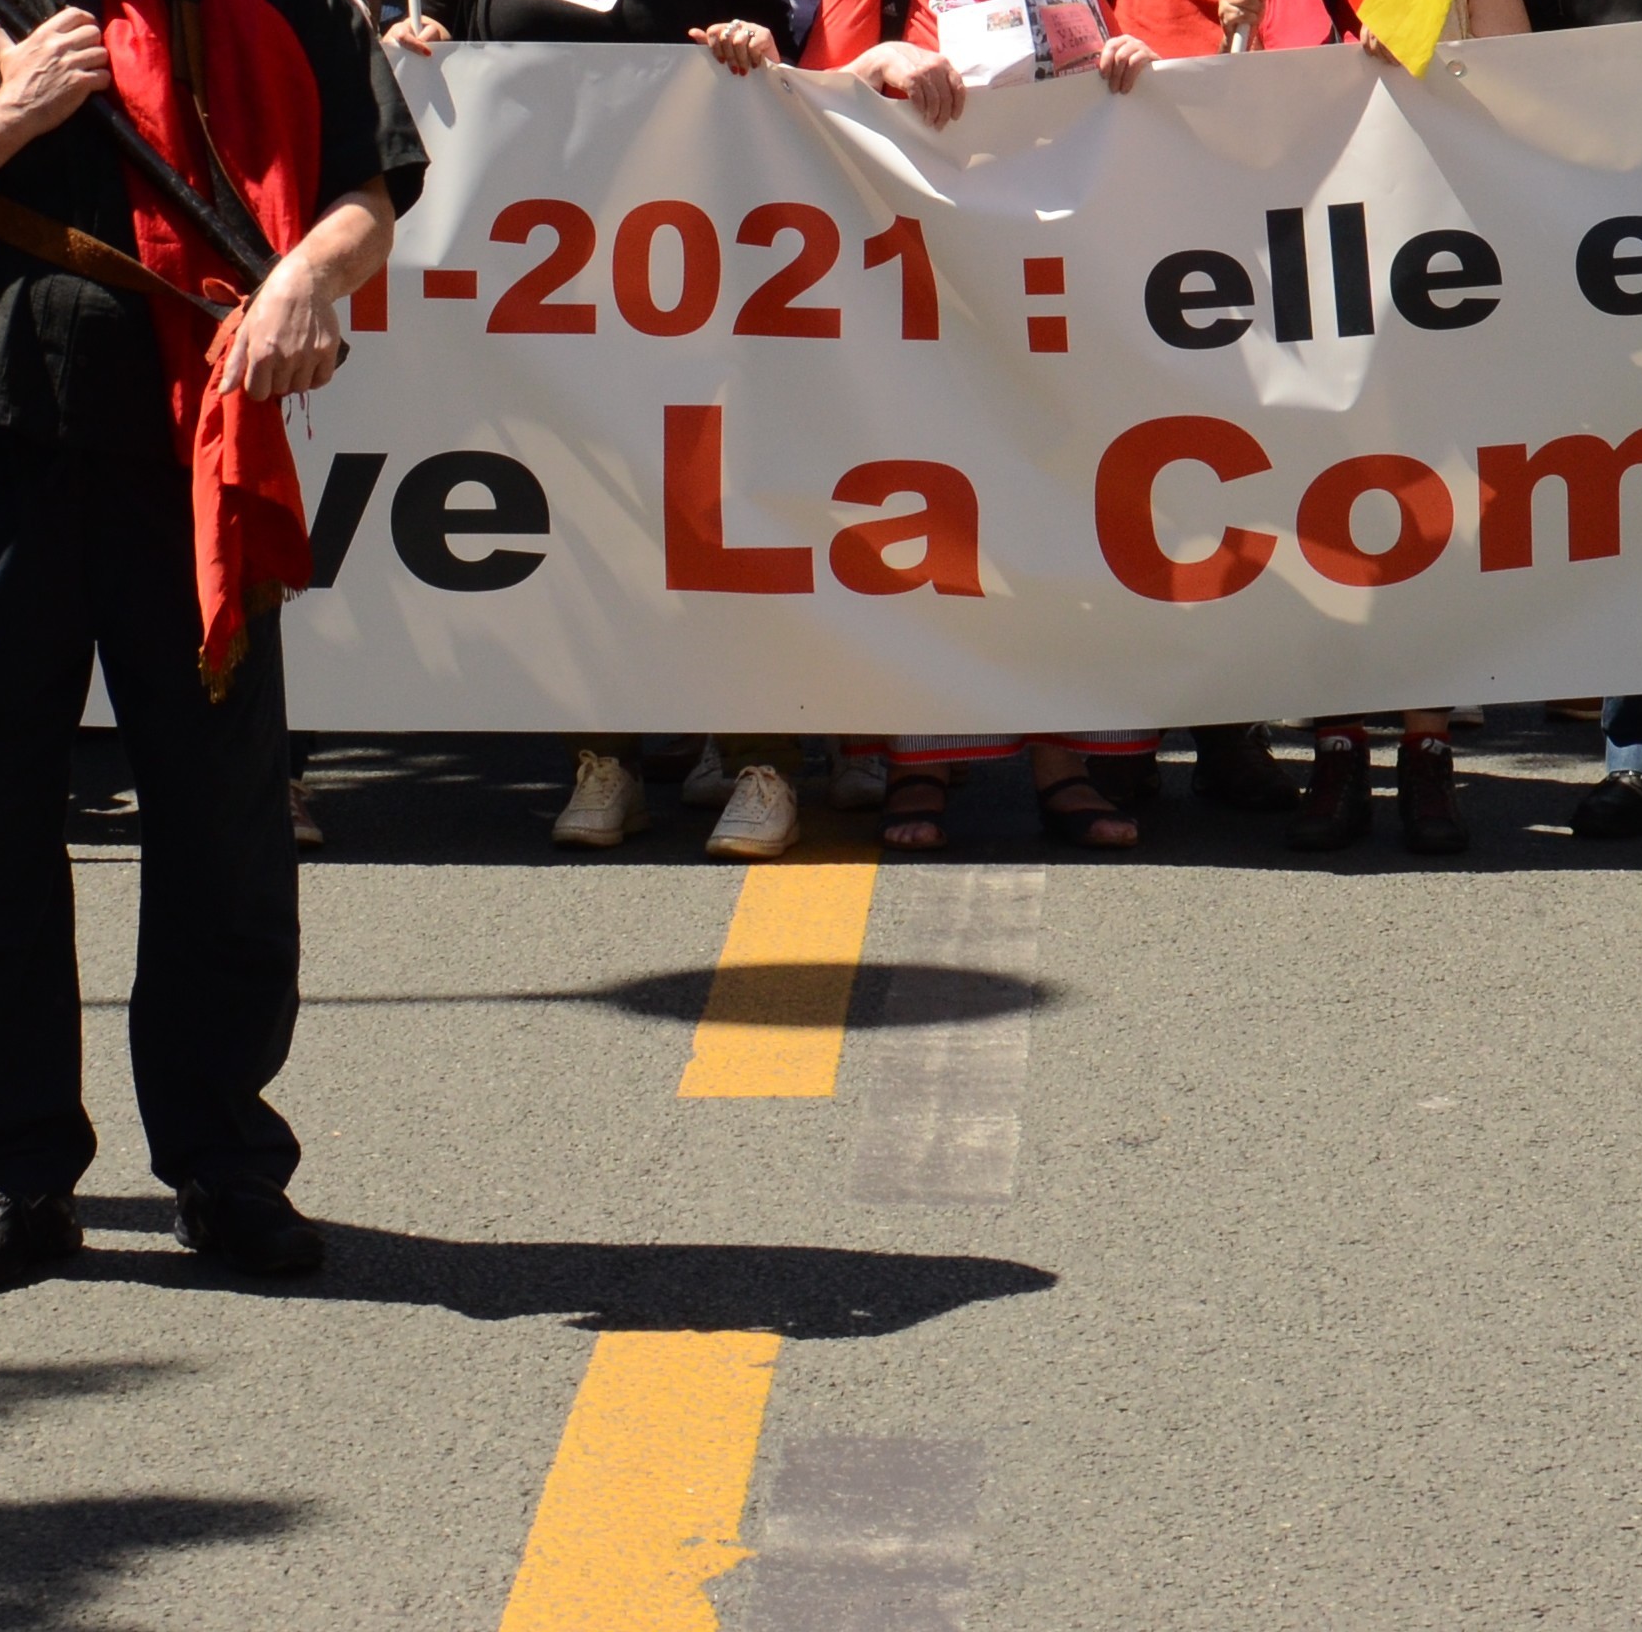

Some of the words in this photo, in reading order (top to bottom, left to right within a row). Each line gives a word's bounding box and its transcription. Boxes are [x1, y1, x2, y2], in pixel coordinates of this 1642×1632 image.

[348, 197, 941, 342] -2021
[1143, 201, 1503, 350] elle
[307, 449, 551, 593] ve
[662, 403, 987, 598] La
